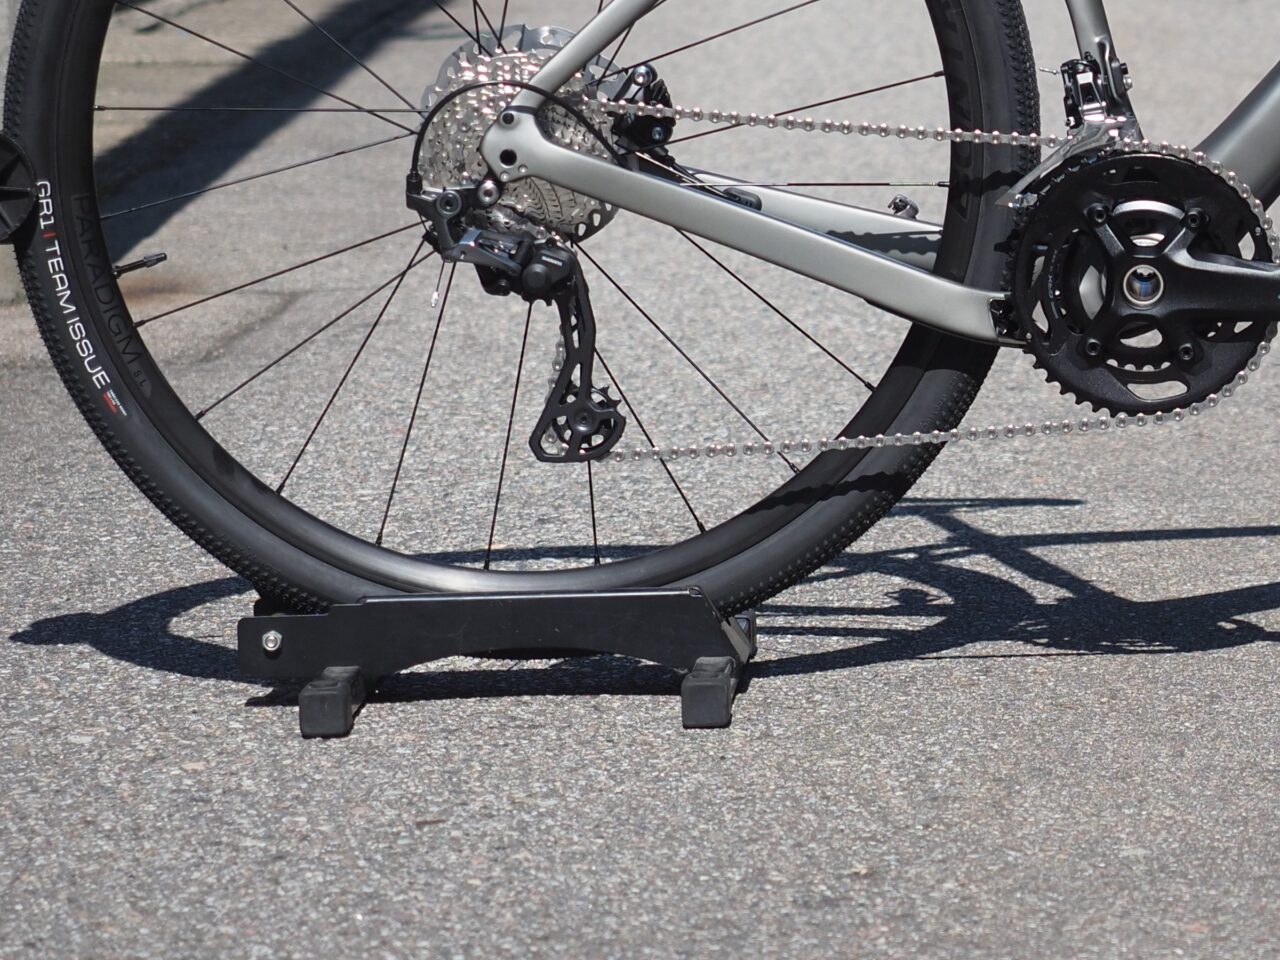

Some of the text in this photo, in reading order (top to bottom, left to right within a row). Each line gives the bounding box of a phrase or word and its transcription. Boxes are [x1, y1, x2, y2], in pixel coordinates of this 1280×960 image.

[36, 181, 110, 389] GR1 TEAM ISSUE
[74, 194, 142, 365] PARADIGM
